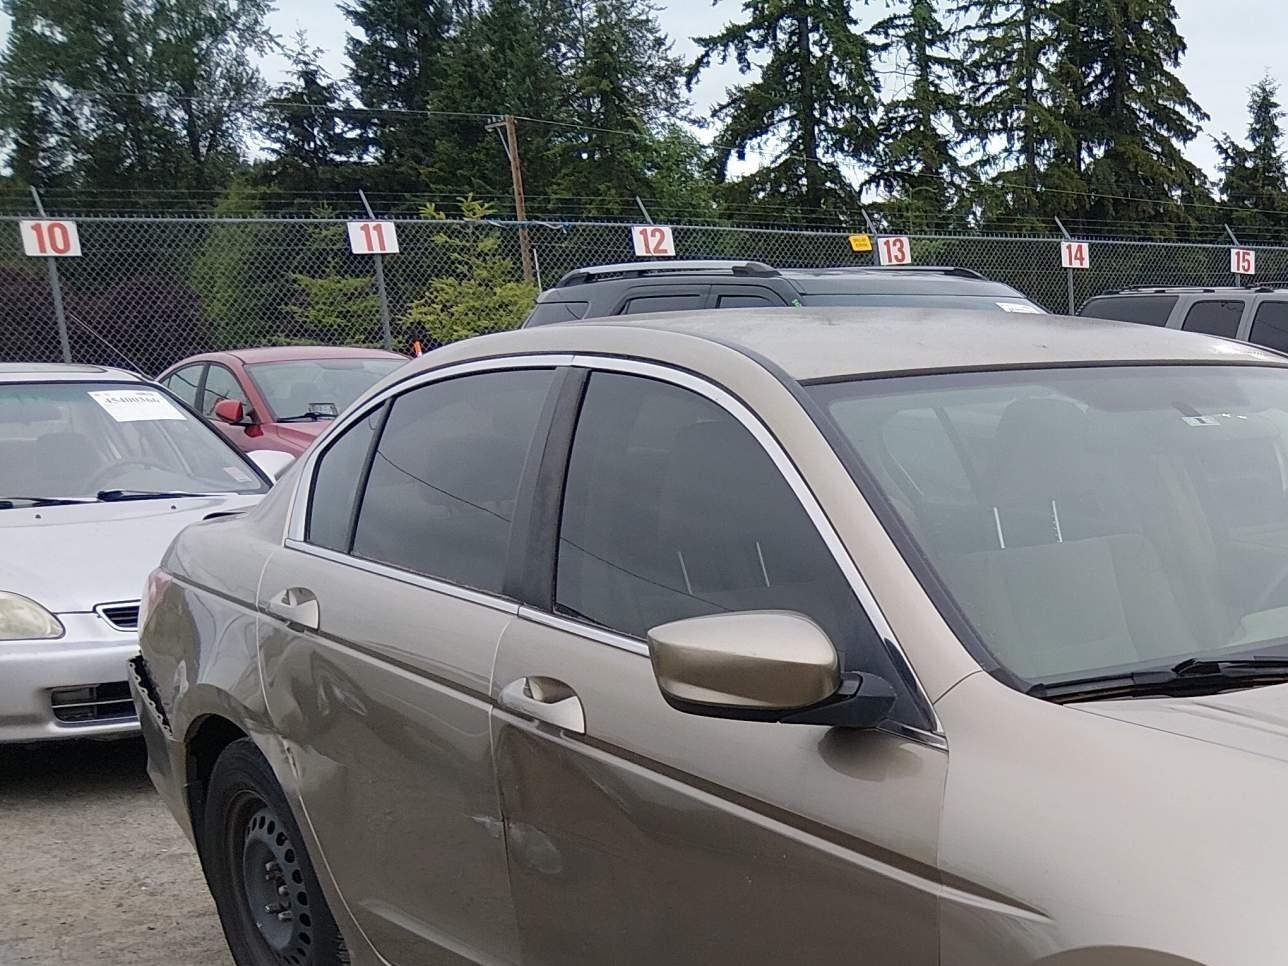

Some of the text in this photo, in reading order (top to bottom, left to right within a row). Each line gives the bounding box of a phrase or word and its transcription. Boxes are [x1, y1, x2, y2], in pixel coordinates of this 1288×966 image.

[32, 220, 72, 255] 10
[361, 223, 387, 252] 11
[640, 227, 668, 254] 12
[884, 238, 906, 263] 13
[1066, 244, 1086, 265] 14
[1236, 251, 1253, 272] 15
